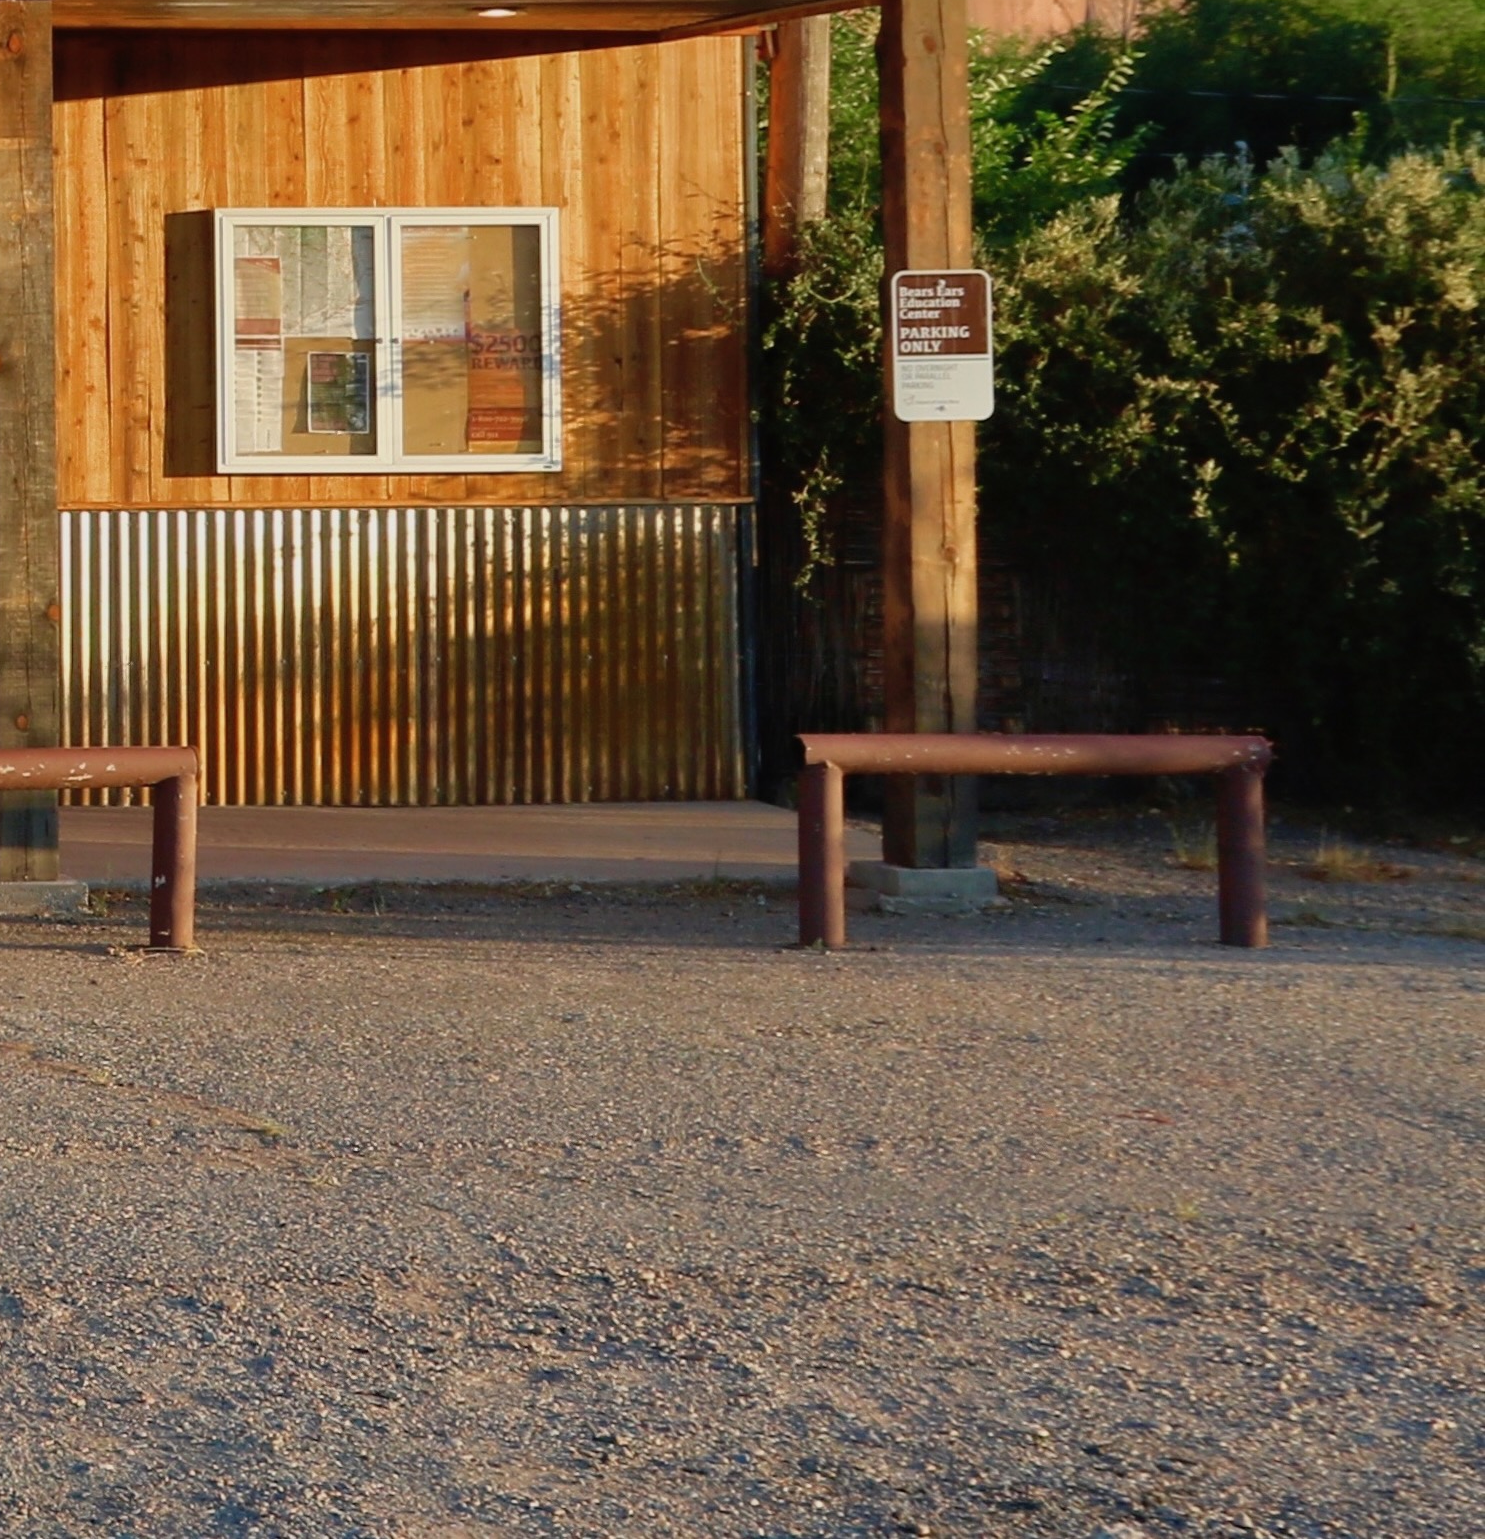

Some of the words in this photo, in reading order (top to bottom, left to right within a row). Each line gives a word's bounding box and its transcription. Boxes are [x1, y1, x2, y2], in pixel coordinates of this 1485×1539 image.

[898, 286, 934, 297] Bears
[937, 286, 965, 297] Ears
[899, 297, 961, 308] Education
[899, 309, 941, 319] Center
[900, 326, 970, 339] PARKING
[900, 340, 942, 353] ONLY
